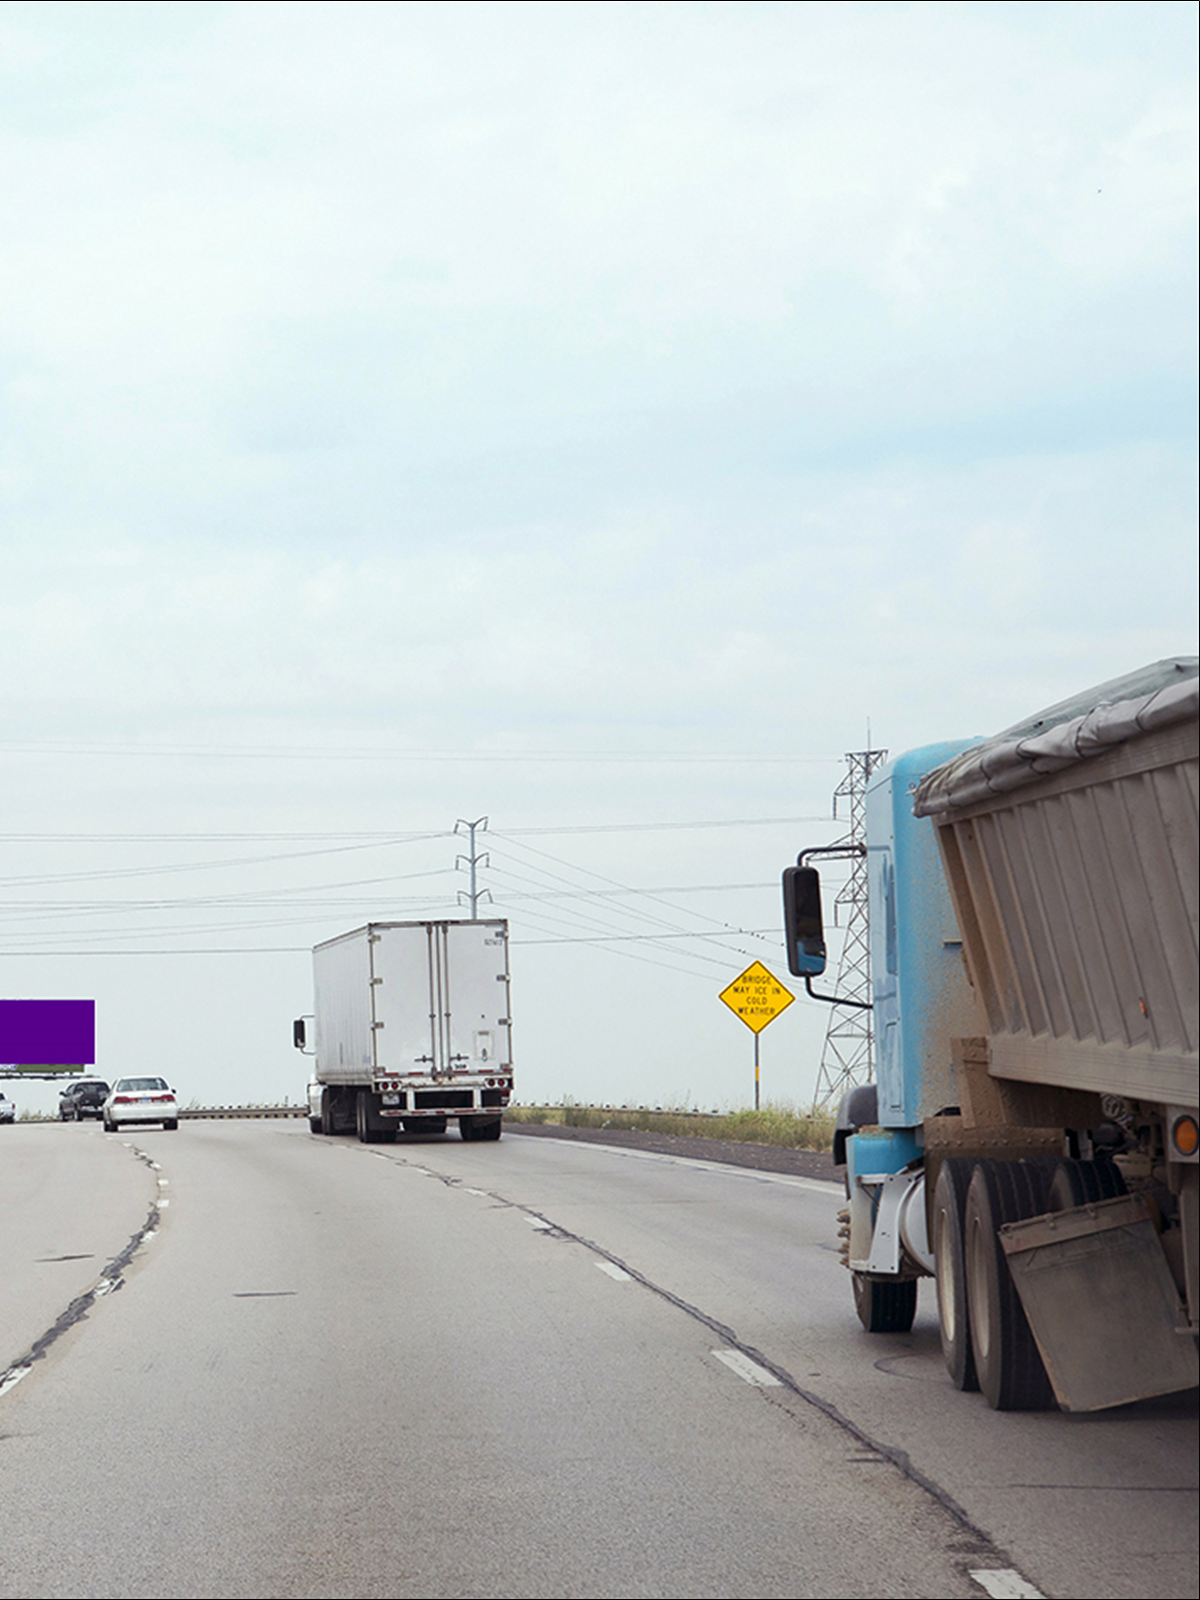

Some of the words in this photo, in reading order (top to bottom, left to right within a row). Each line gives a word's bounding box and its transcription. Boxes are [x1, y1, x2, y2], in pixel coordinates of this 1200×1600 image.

[742, 976, 772, 985] BRIDGE
[733, 986, 750, 994] MAY
[754, 986, 767, 995] ICE
[746, 996, 768, 1005] COLD
[738, 1007, 776, 1015] WEATHER
